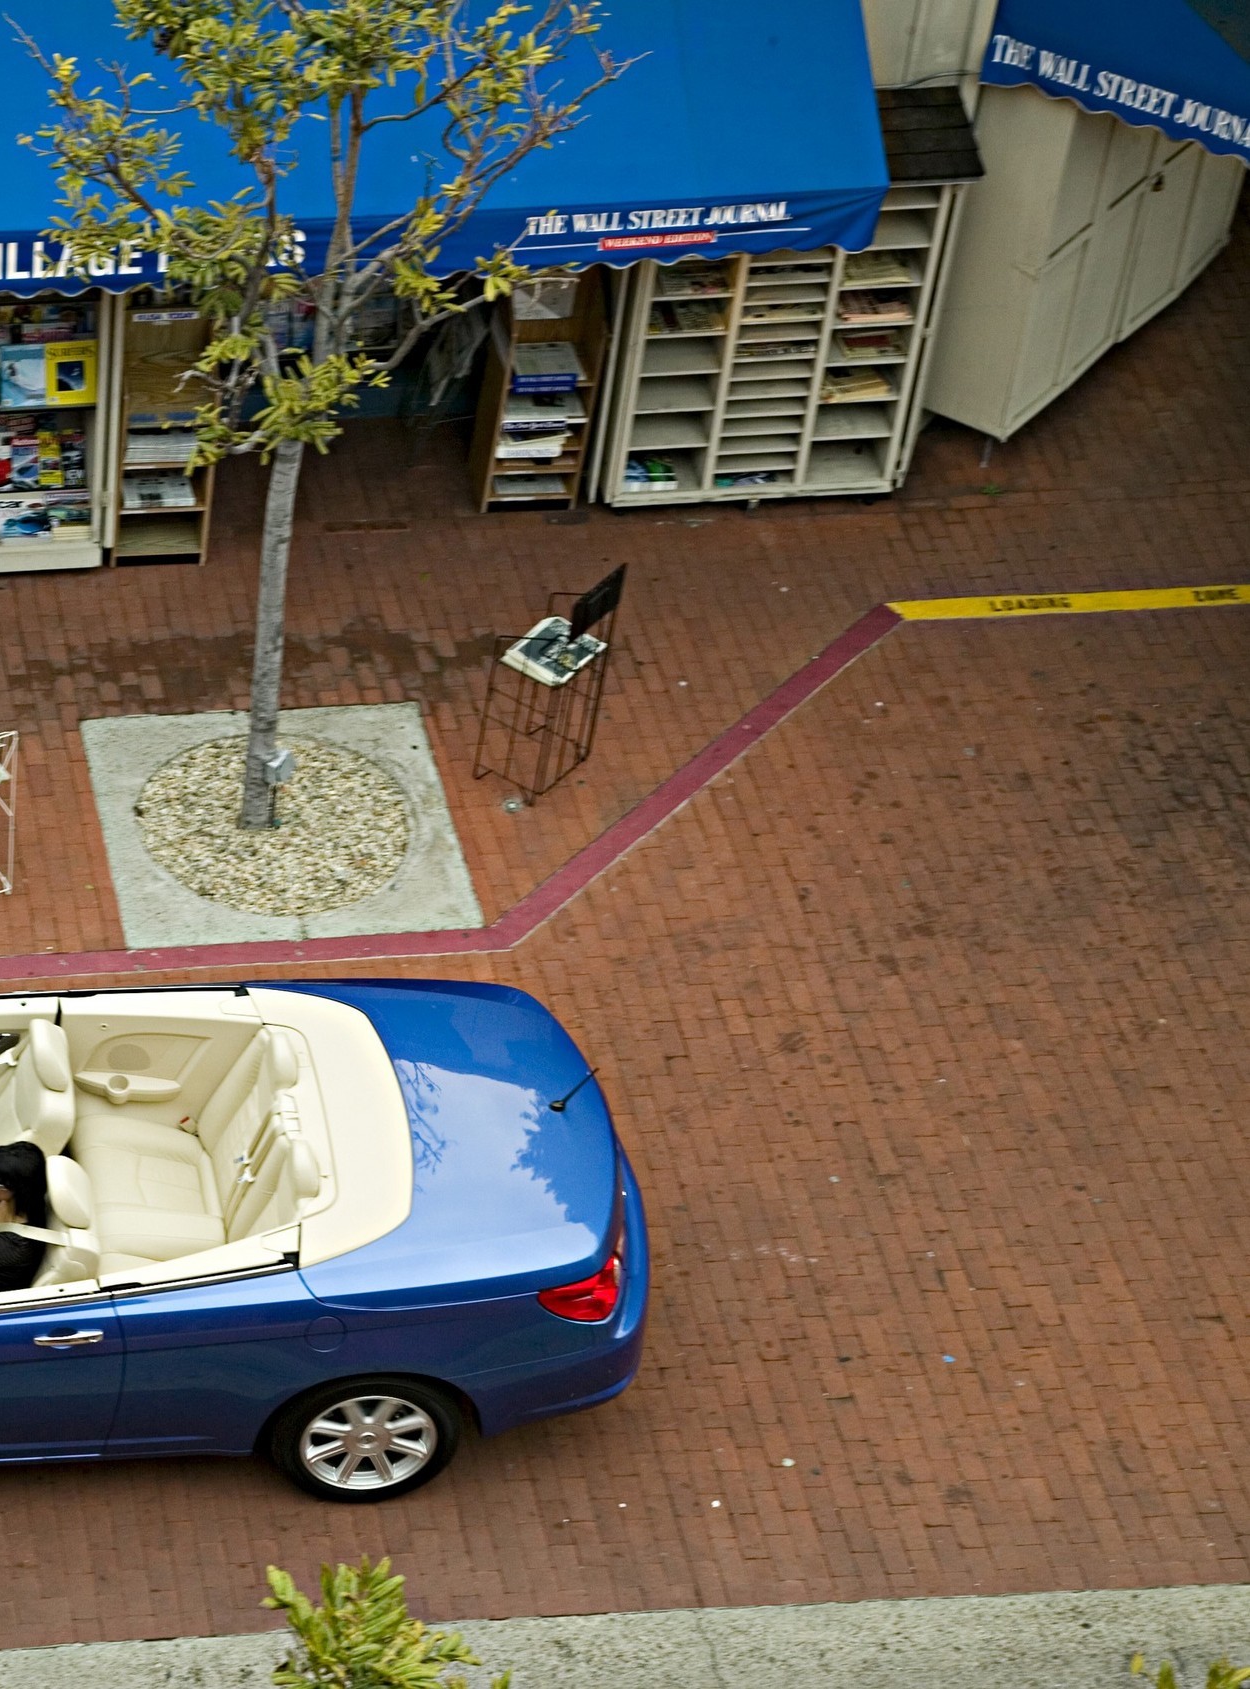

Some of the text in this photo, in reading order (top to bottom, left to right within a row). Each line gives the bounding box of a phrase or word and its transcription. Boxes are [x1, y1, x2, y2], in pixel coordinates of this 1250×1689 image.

[992, 34, 1036, 70] THE
[1038, 50, 1091, 92] WALL
[1093, 70, 1178, 119] STREET
[526, 214, 568, 236] THE
[572, 212, 624, 233] WALL
[627, 207, 705, 230] STREET
